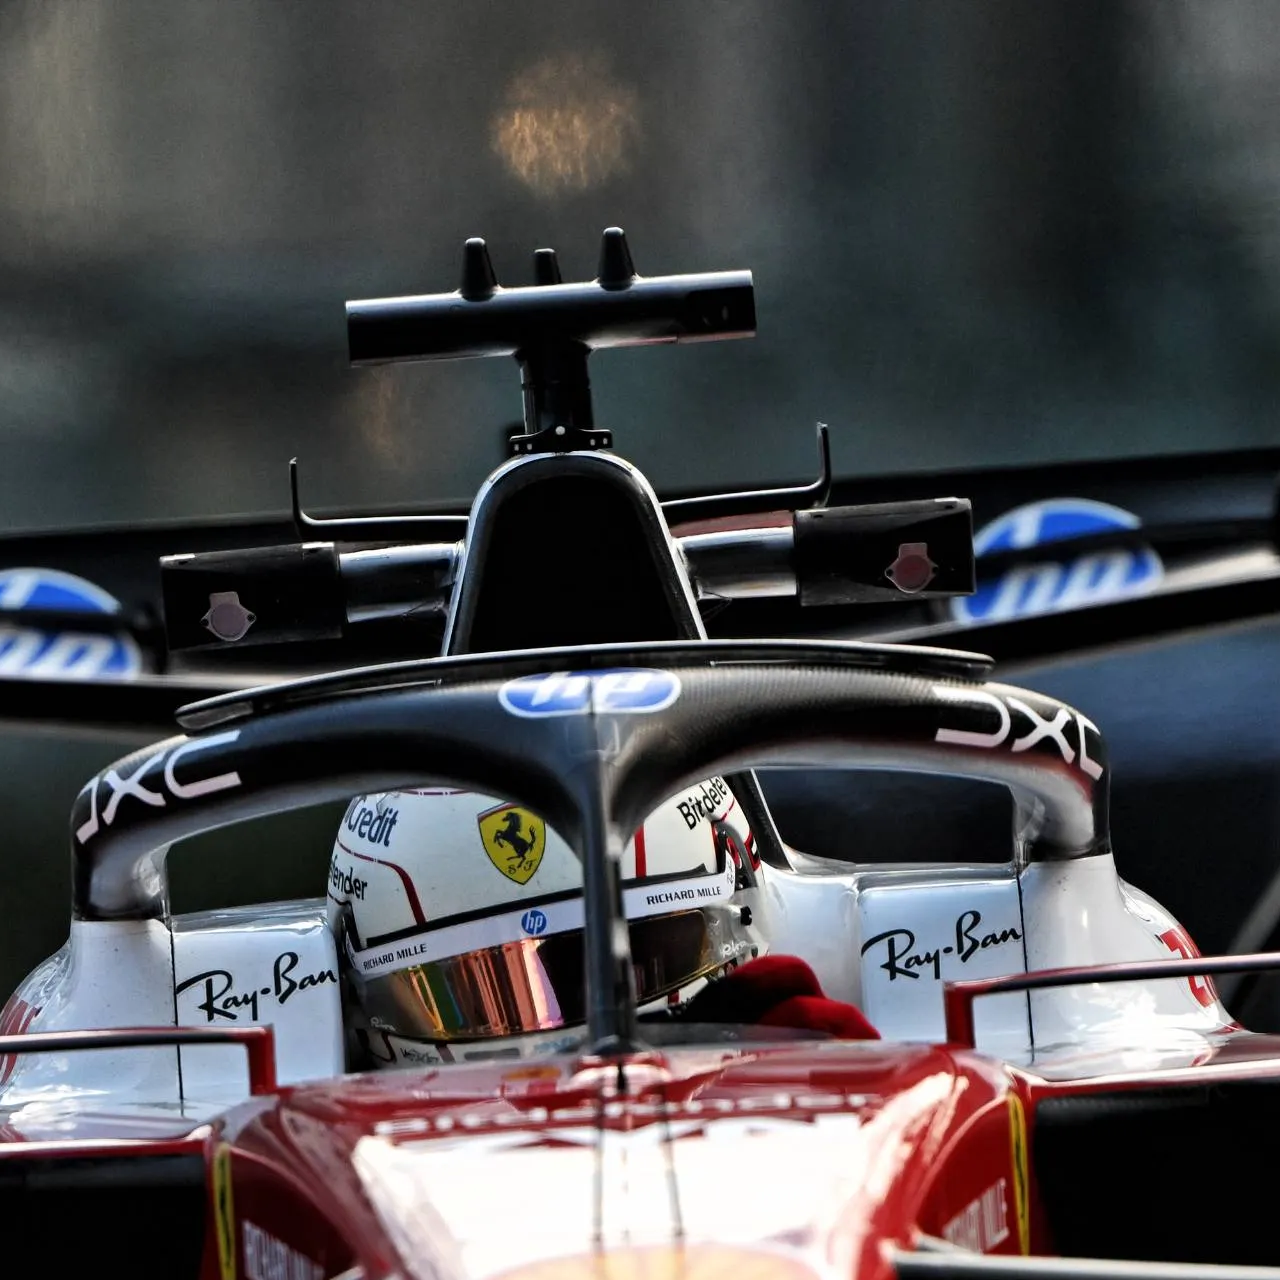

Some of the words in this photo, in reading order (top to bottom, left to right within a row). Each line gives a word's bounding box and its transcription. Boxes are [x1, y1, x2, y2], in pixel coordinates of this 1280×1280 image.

[529, 671, 656, 714] hp
[675, 775, 728, 831] Bitdefe
[646, 889, 695, 906] RICHARD
[697, 885, 723, 898] MILLE
[524, 909, 545, 936] hp
[363, 951, 395, 971] RICHARD
[396, 943, 428, 961] MILLE
[861, 909, 1022, 981] Ray-Ban
[176, 951, 338, 1023] Ray-Ban
